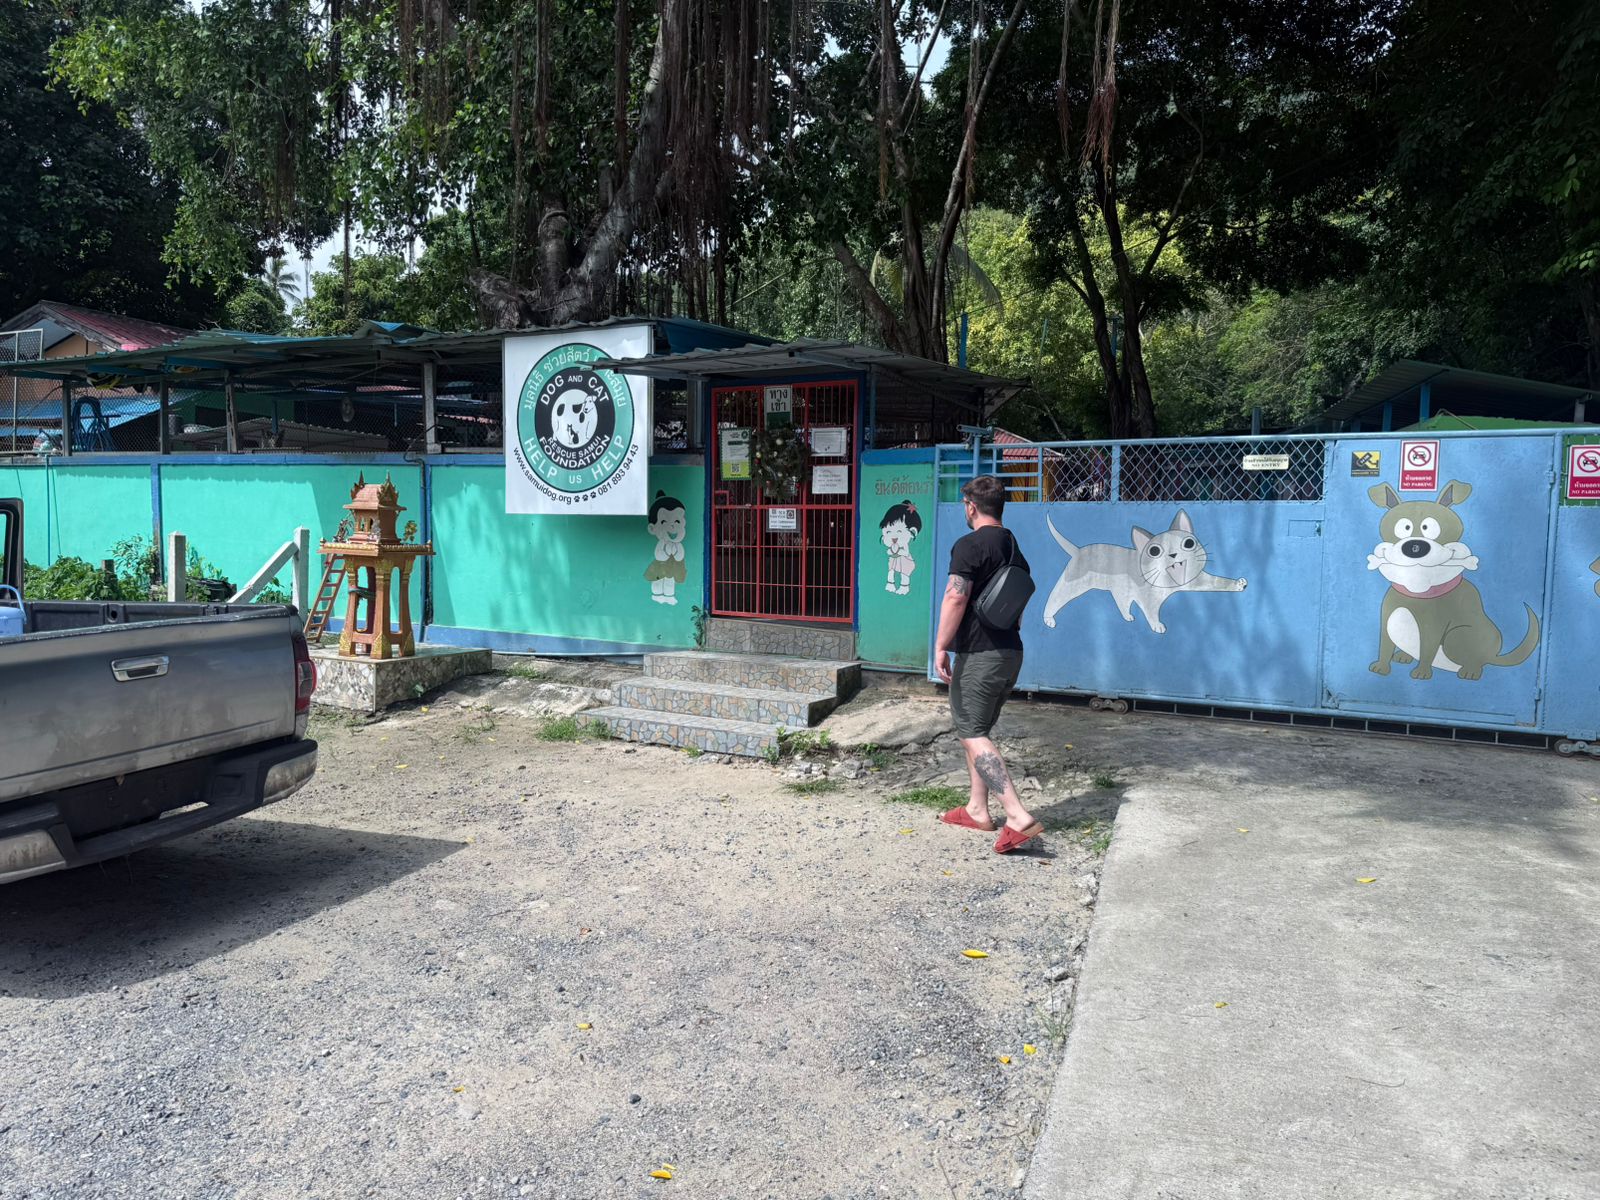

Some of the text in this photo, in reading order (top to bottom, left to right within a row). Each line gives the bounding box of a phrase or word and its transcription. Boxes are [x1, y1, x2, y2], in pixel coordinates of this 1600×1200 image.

[540, 375, 609, 406] DOG AND CAT
[769, 389, 788, 399] ทาง
[771, 398, 786, 411] เข้า
[524, 435, 625, 484] HELP US HELP
[539, 435, 610, 468] FOUNDATION
[547, 436, 602, 459] RESCUE SAMUI
[513, 447, 572, 505] www.samuidog.org
[597, 443, 639, 496] 081 893 94 43
